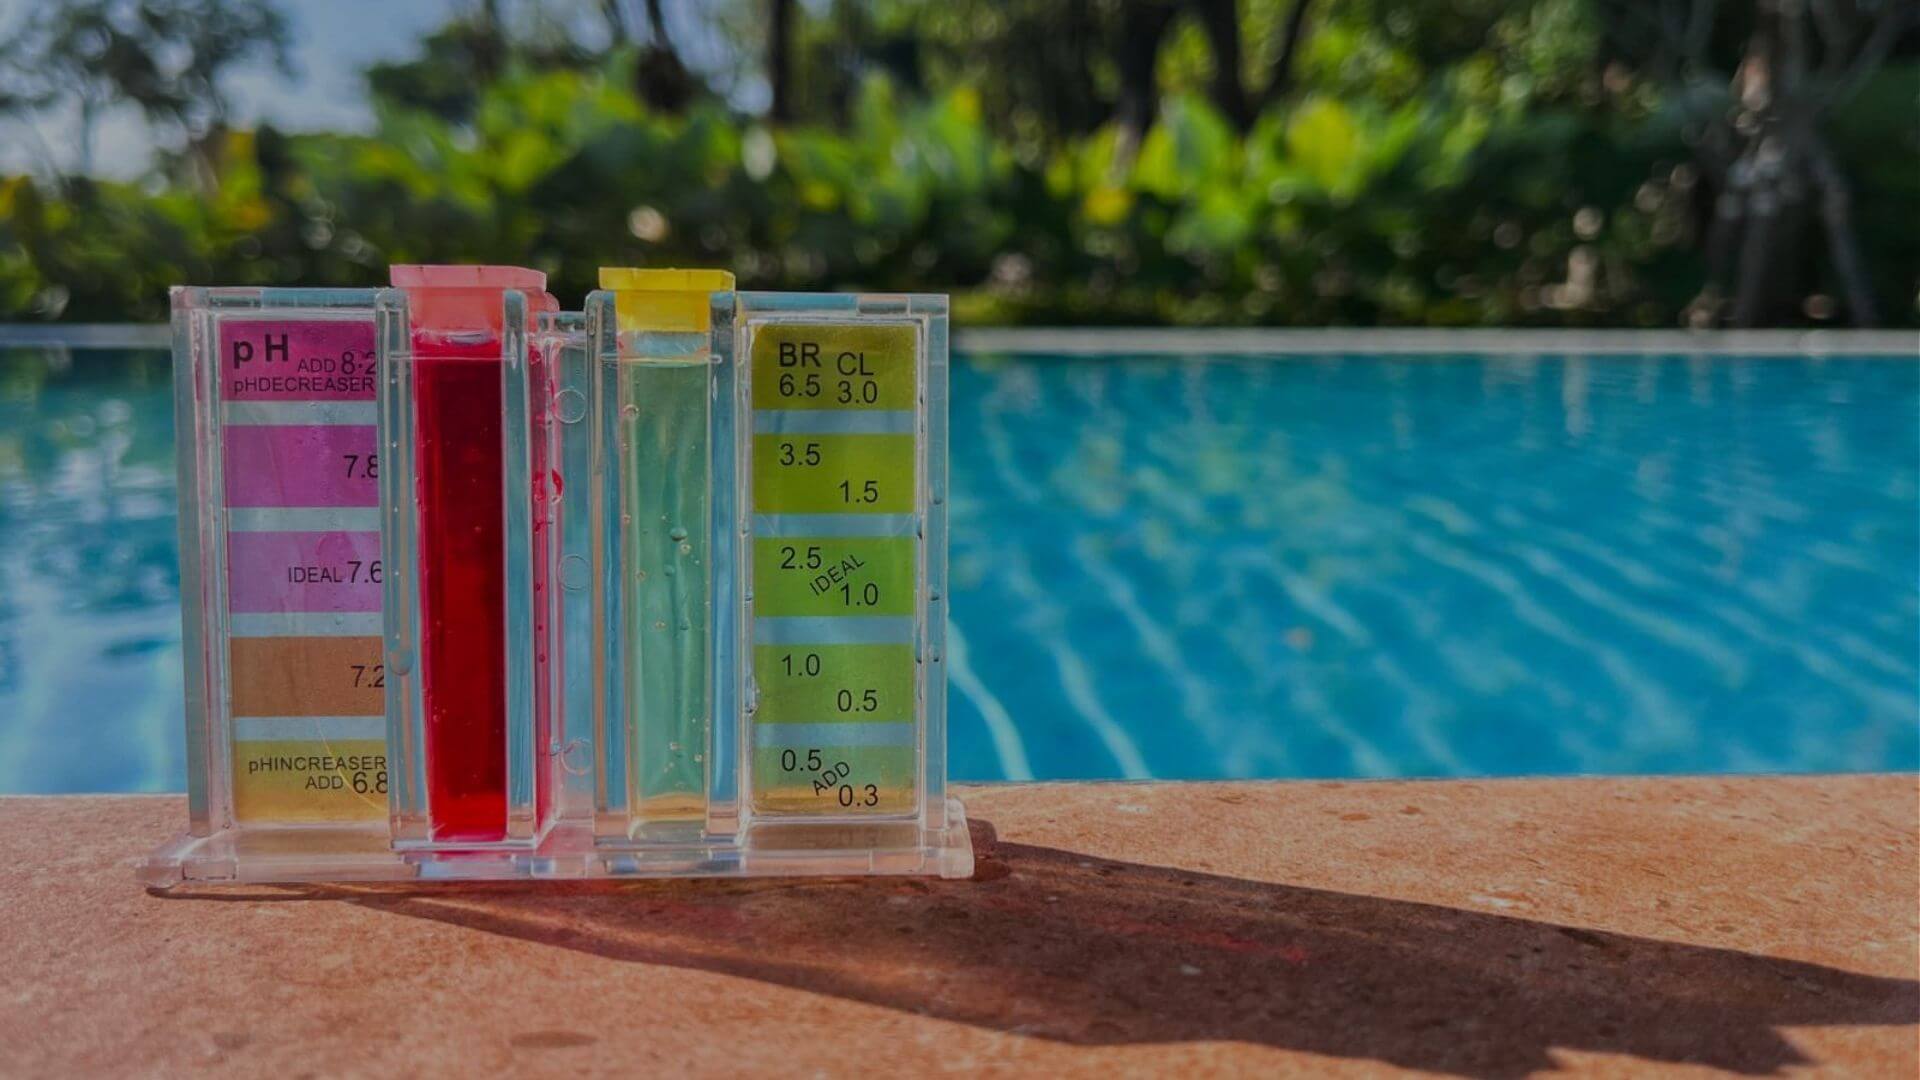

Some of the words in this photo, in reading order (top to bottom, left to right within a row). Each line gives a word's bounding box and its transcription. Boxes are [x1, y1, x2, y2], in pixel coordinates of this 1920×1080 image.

[298, 359, 336, 373] ADD
[779, 343, 821, 368] BR
[837, 352, 874, 376] CL
[234, 377, 375, 394] pHDECREASER
[779, 374, 821, 397] 6.5
[837, 381, 877, 404] 3.0
[780, 443, 821, 466] 3.5
[344, 455, 378, 479] 7.8
[840, 480, 878, 503] 1.5
[781, 546, 822, 570] 2.5
[288, 567, 342, 583] IDEAL
[347, 561, 382, 584] 7.6
[809, 554, 866, 596] IDEAL
[840, 583, 878, 605] 1.0
[351, 666, 384, 688] 7.2
[782, 654, 820, 677] 1.0
[837, 690, 877, 712] 0.5
[249, 756, 386, 774] pHINCREASER
[781, 749, 822, 772] 0.5
[305, 776, 343, 790] ADD
[353, 772, 388, 794] 6.8
[813, 762, 850, 796] ADD
[839, 784, 878, 807] 0.3
